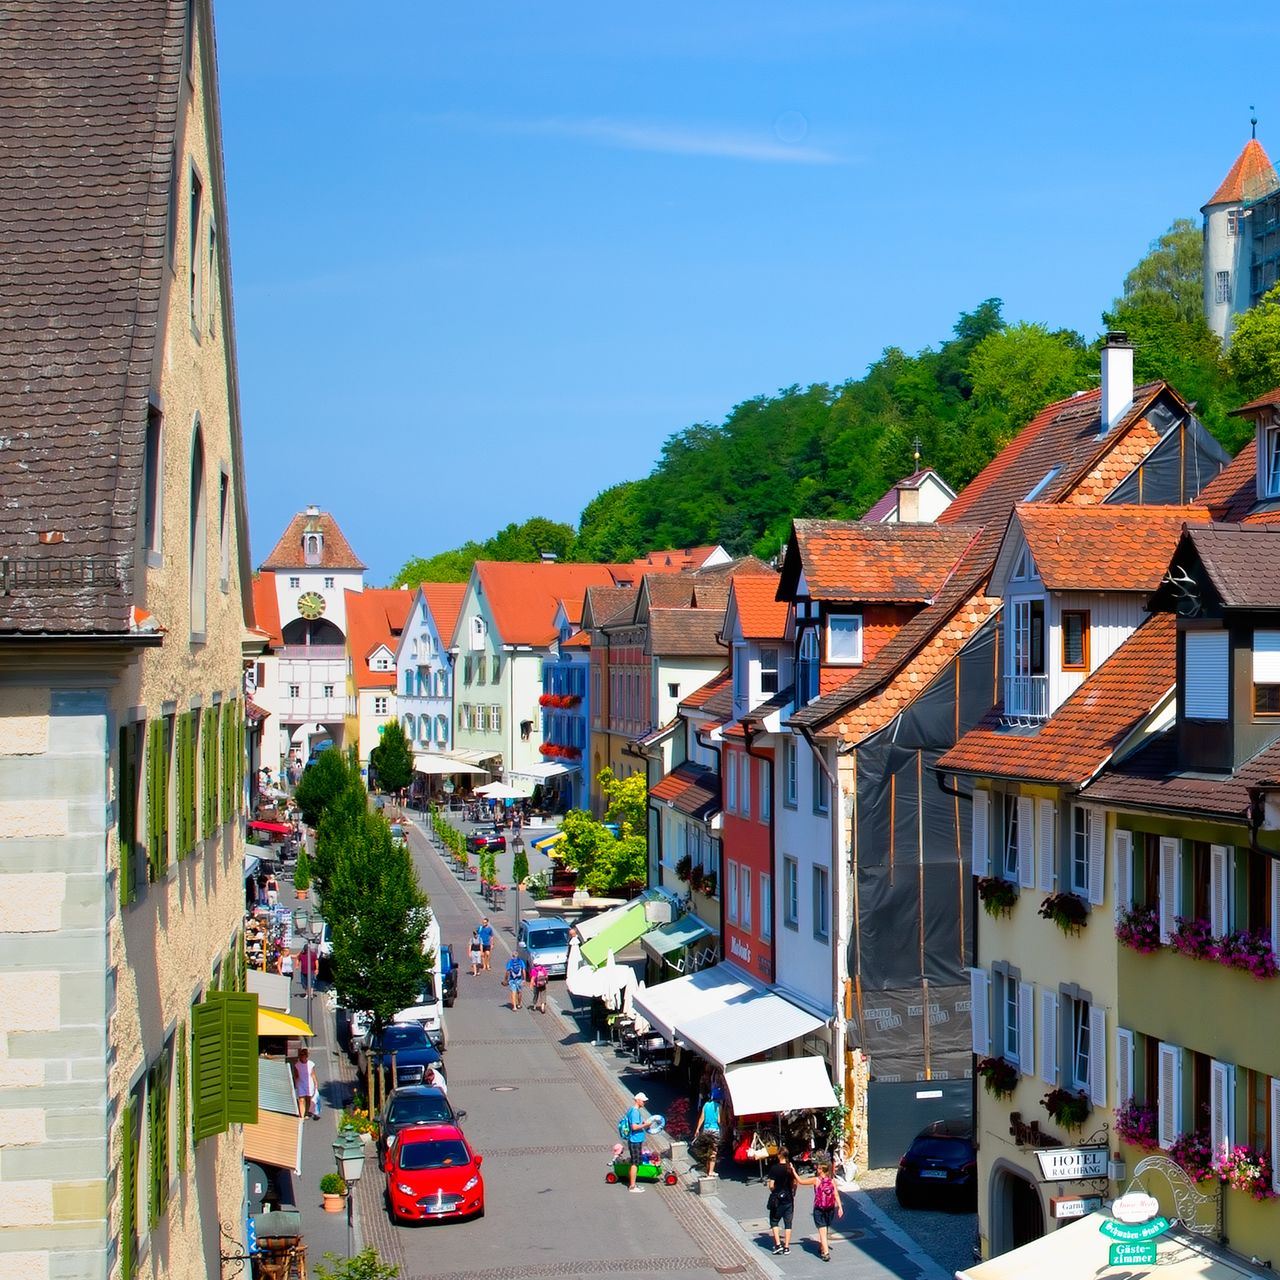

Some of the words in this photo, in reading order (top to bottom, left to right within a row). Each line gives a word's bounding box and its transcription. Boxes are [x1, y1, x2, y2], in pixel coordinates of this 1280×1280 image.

[1053, 1153, 1101, 1167] HOTEL
[1062, 1199, 1084, 1210] Garni
[1116, 1244, 1151, 1254] Gäste-
[1113, 1254, 1152, 1264] zimmer
